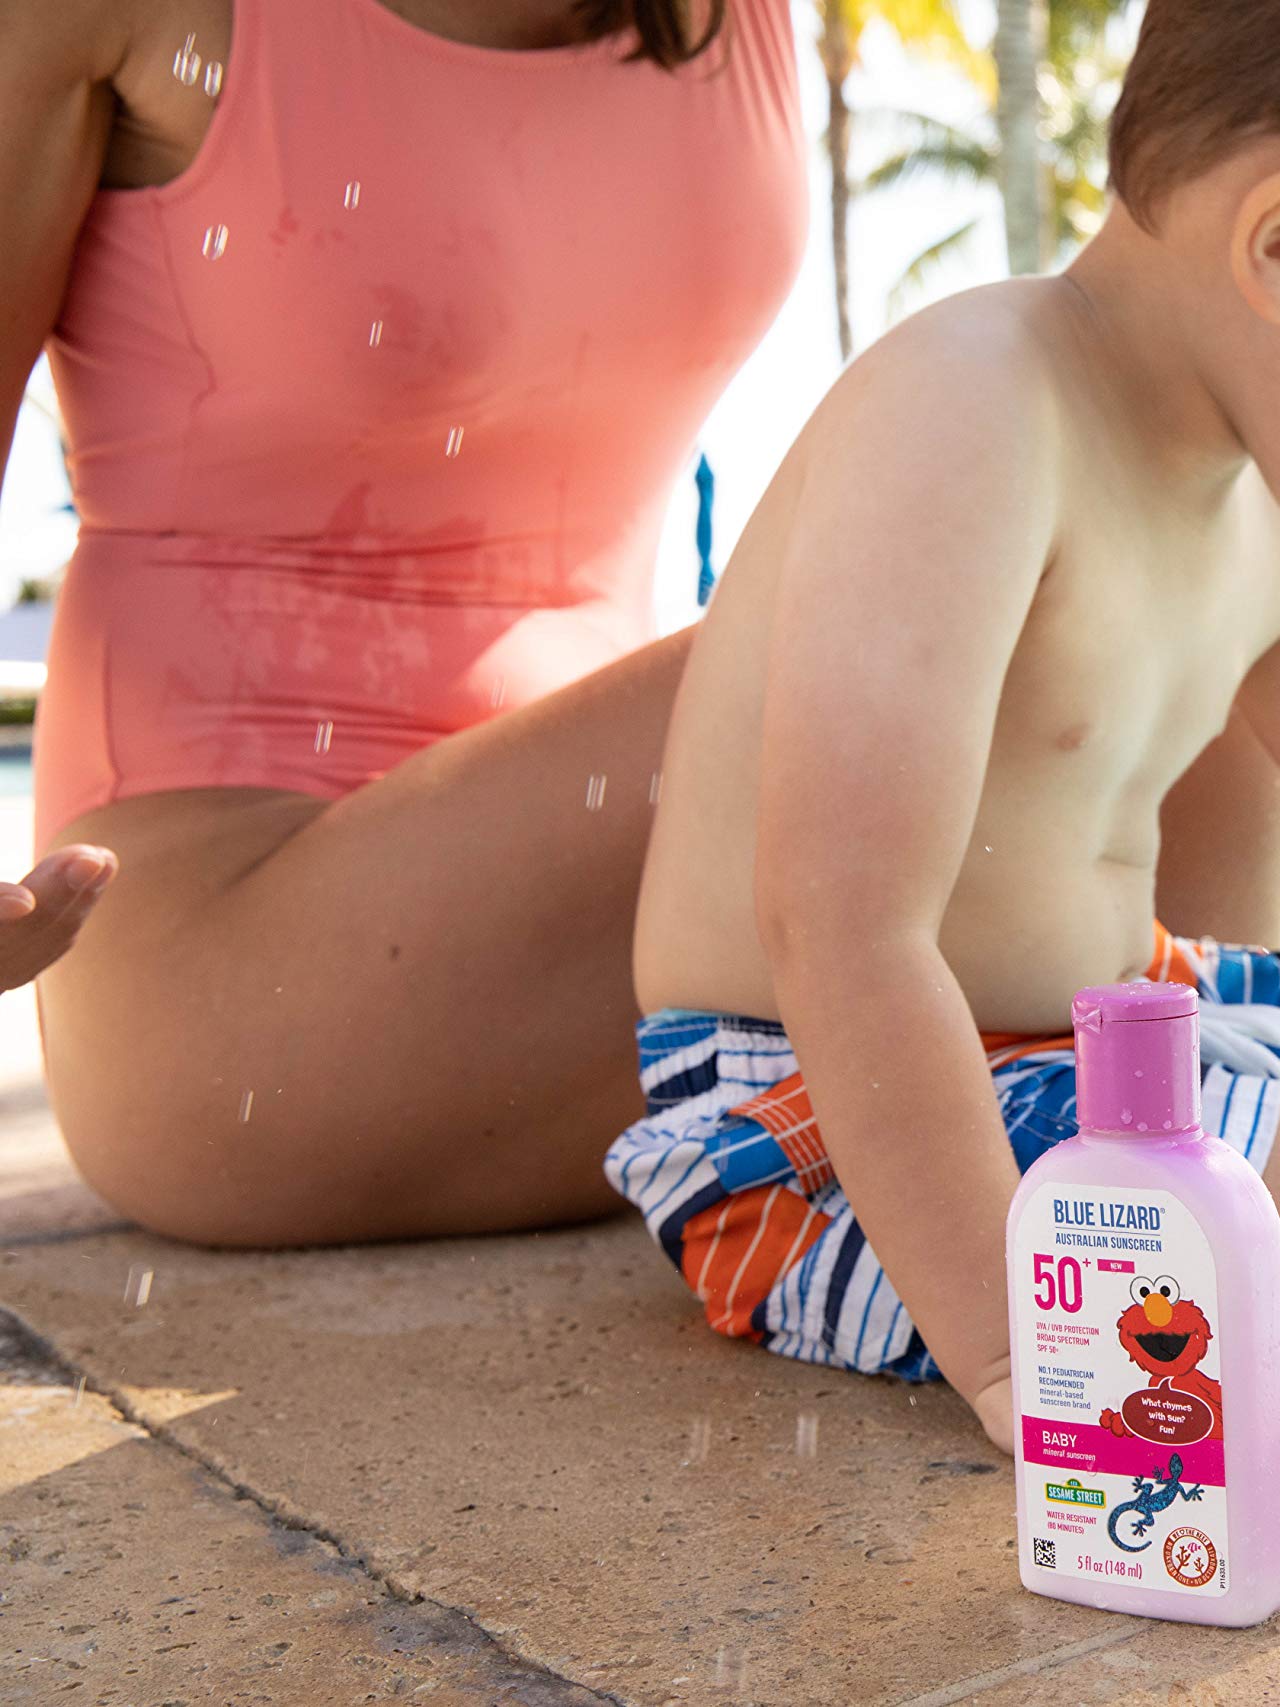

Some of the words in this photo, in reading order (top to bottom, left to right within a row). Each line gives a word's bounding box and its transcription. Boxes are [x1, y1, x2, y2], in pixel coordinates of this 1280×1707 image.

[1053, 1199, 1095, 1226] BLUE
[1056, 1233, 1108, 1248] AUSTRALIAN
[1111, 1237, 1162, 1252] SUNSCREEN
[1036, 1322, 1046, 1330] UVA
[1052, 1324, 1062, 1332] UVB
[1064, 1325, 1099, 1335] PROTECTION
[1036, 1333, 1055, 1342] BROAD
[1057, 1335, 1090, 1346] SPECTRUM
[1037, 1344, 1047, 1352] SPF
[1053, 1368, 1094, 1379] PEDIATRICIAN
[1039, 1377, 1084, 1389] RECOMMENDED
[1040, 1388, 1084, 1399] mineral-based
[1040, 1398, 1070, 1407] sunscreen
[1073, 1400, 1091, 1409] brand
[1141, 1397, 1161, 1407] What
[1162, 1401, 1192, 1412] rhymes
[1148, 1412, 1165, 1420] with
[1042, 1431, 1077, 1448] BABY
[1043, 1447, 1065, 1457] mineral
[1067, 1452, 1096, 1461] sunscreen
[1048, 1486, 1075, 1500] SESAME
[1076, 1490, 1102, 1504] STREET
[1047, 1510, 1065, 1520] WATER
[1066, 1513, 1096, 1525] RESISTANT
[1057, 1523, 1084, 1534] MINUTES)
[1078, 1556, 1083, 1569] 5
[1085, 1555, 1091, 1570] fl
[1093, 1563, 1103, 1573] oz
[1105, 1560, 1125, 1576] (148
[1128, 1563, 1142, 1580] ml)
